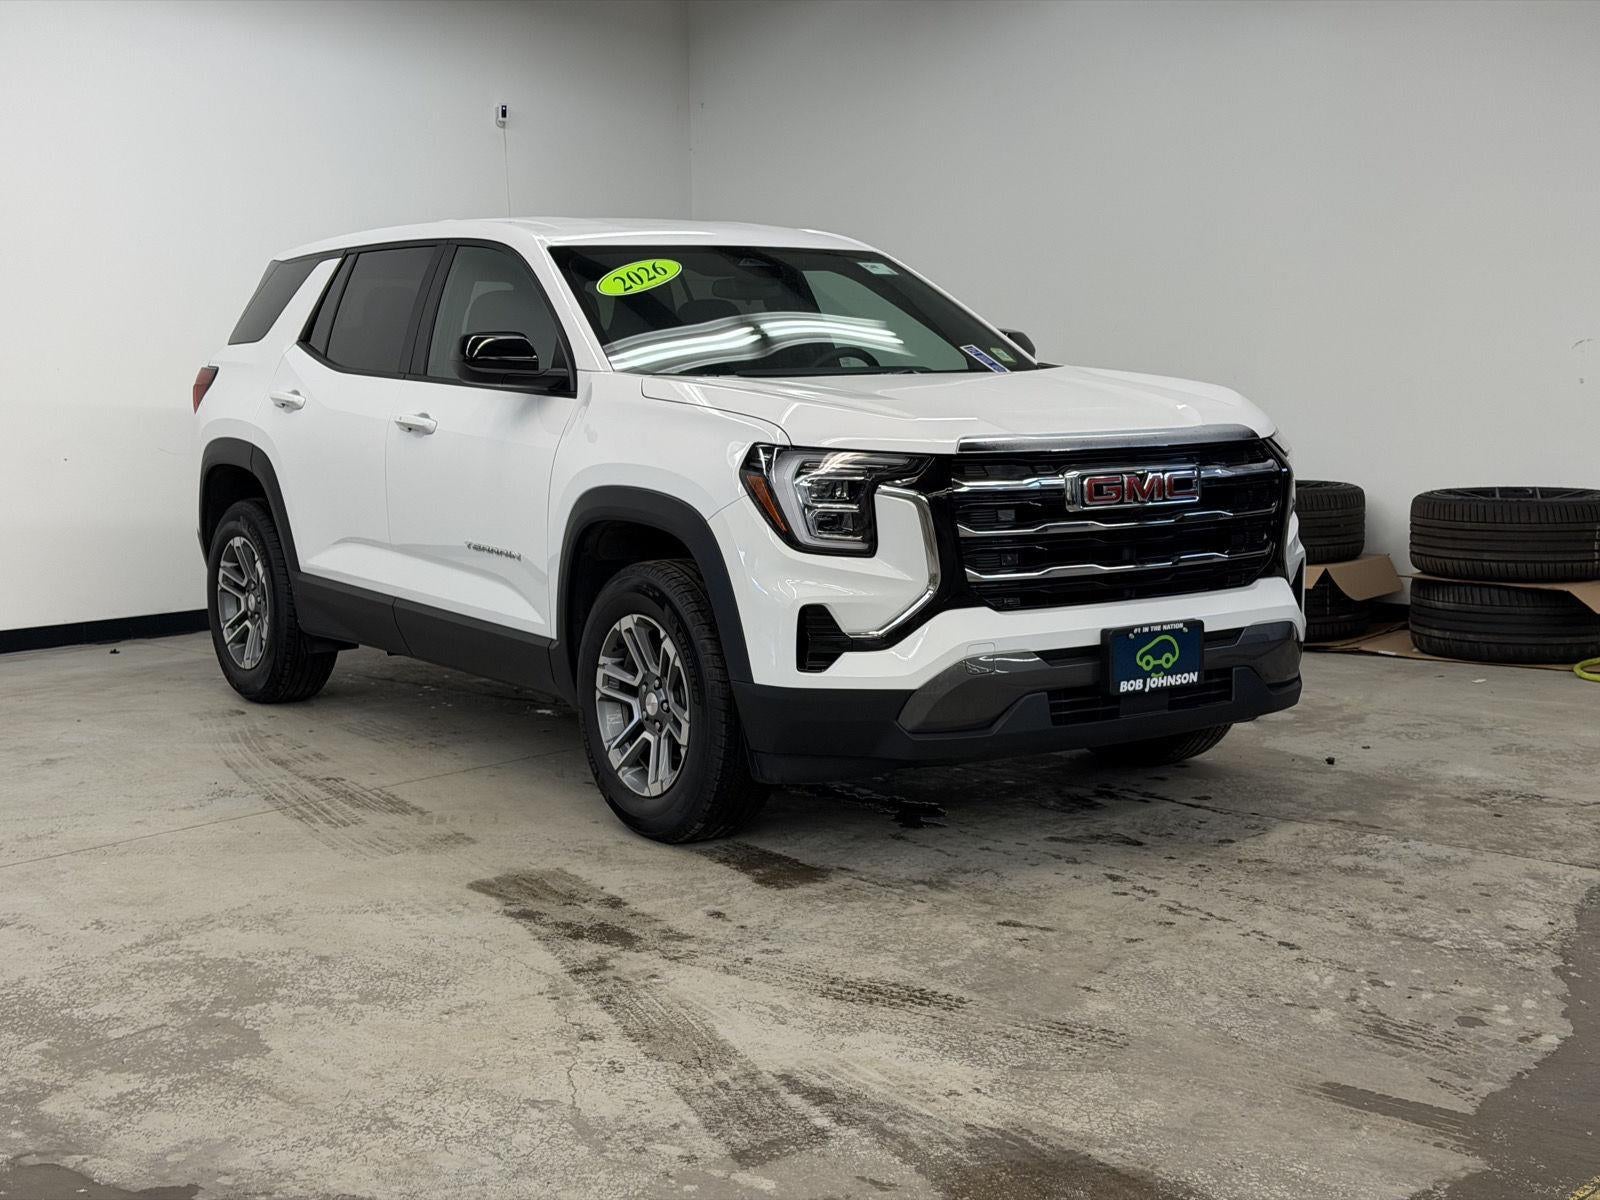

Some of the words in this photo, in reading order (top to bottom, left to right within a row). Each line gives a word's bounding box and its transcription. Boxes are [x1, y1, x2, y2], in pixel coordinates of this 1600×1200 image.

[612, 261, 668, 292] 2026
[1082, 470, 1199, 506] GMC
[1150, 624, 1161, 632] THE
[1162, 622, 1184, 631] NATION
[1120, 679, 1143, 693] BOB
[1144, 672, 1198, 692] JOHNSON
